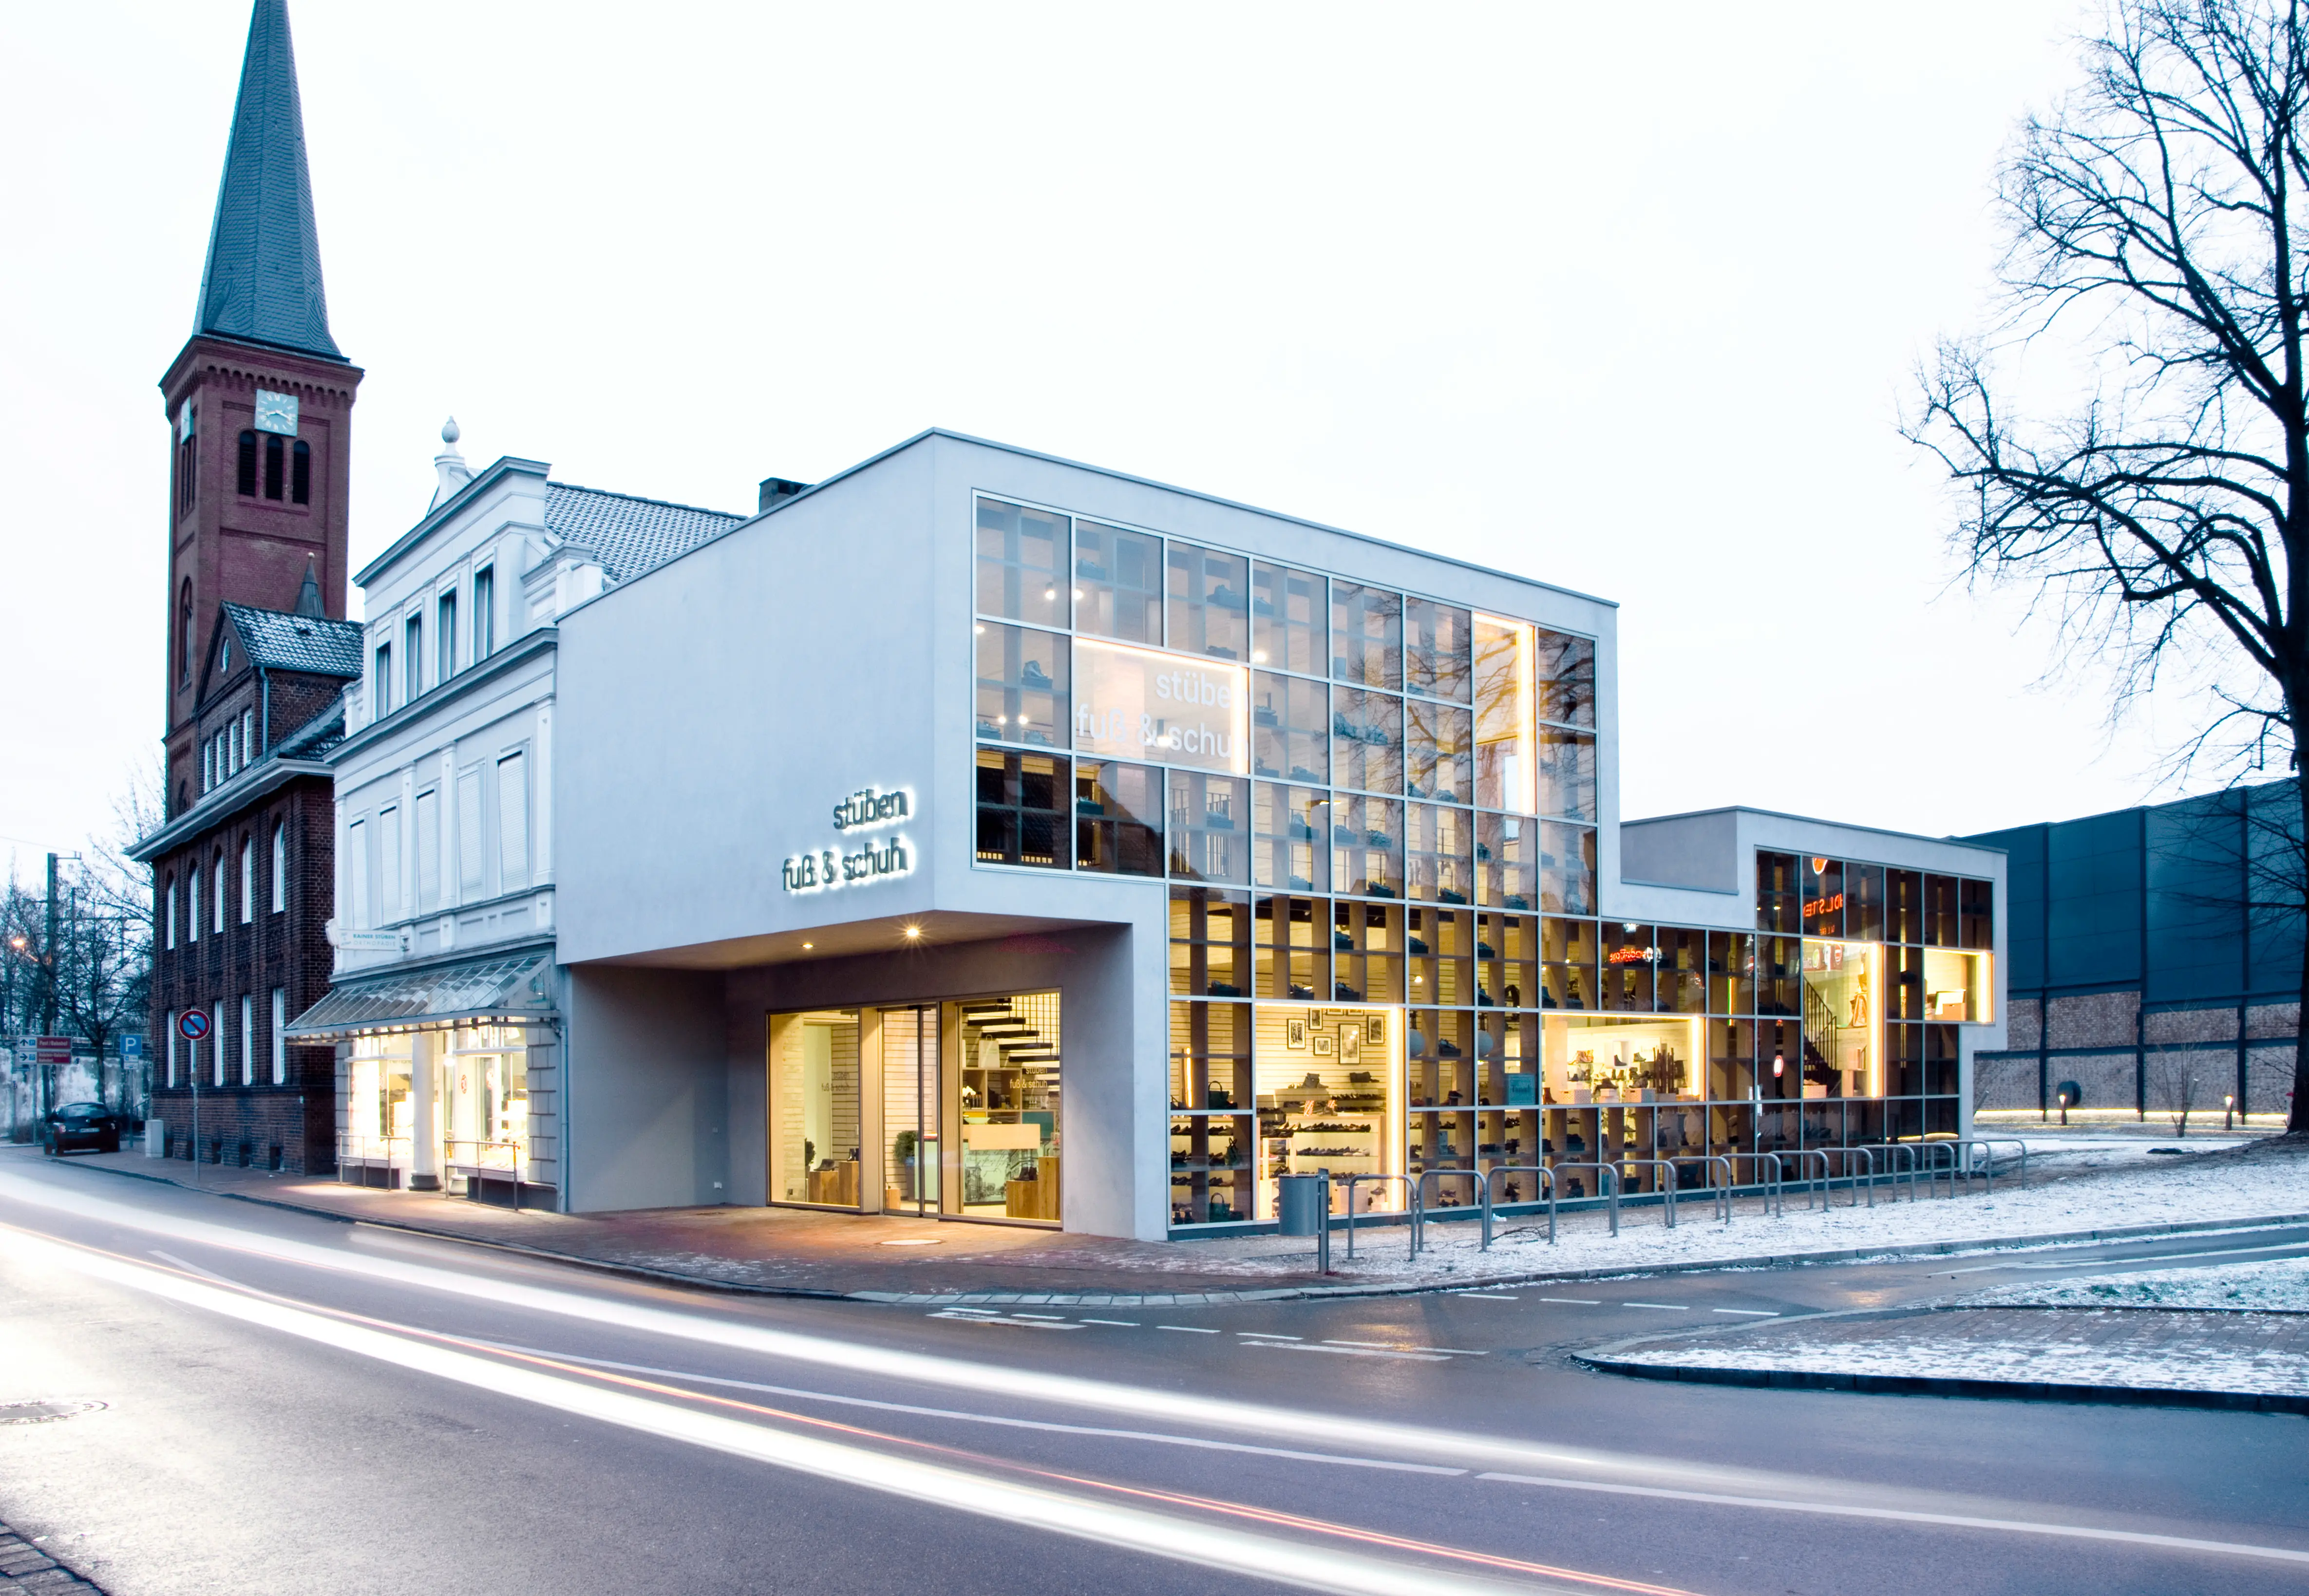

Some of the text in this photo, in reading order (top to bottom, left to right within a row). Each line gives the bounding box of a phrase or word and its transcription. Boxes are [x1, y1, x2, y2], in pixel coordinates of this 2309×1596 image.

[1155, 670, 1249, 712] stübe
[1077, 703, 1249, 761] fuß & schu
[833, 789, 909, 830] stüben
[782, 836, 909, 891] fuß & schuh
[125, 1037, 136, 1052] P
[1010, 1078, 1047, 1089] fuß & schuh
